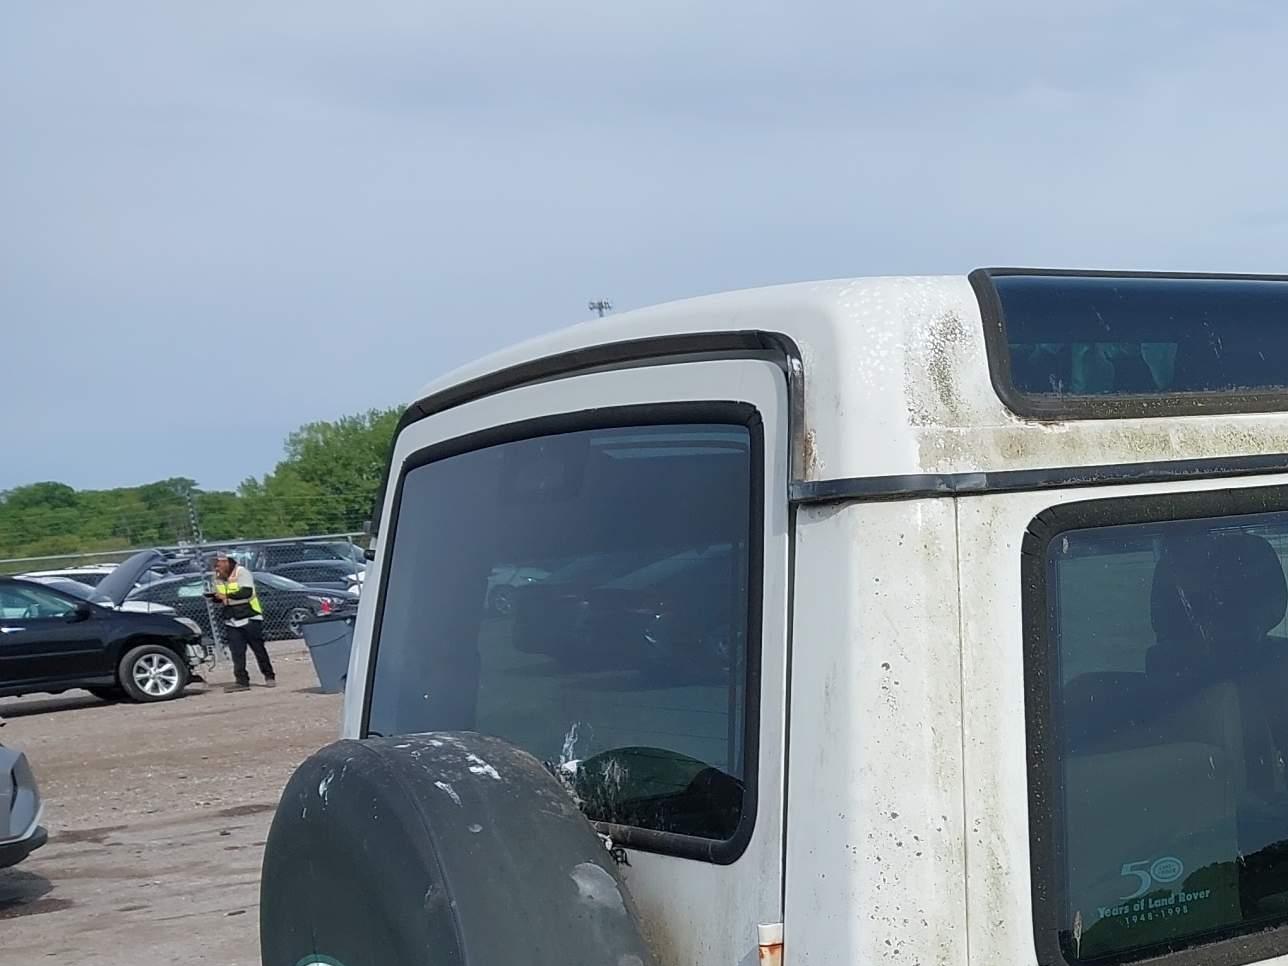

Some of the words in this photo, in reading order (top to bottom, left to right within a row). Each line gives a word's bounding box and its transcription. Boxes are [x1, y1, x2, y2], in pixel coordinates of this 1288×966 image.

[1119, 856, 1184, 899] 50
[1097, 904, 1130, 919] Years
[1133, 899, 1145, 912] of
[1148, 894, 1176, 909] Land
[1179, 889, 1211, 903] Rover
